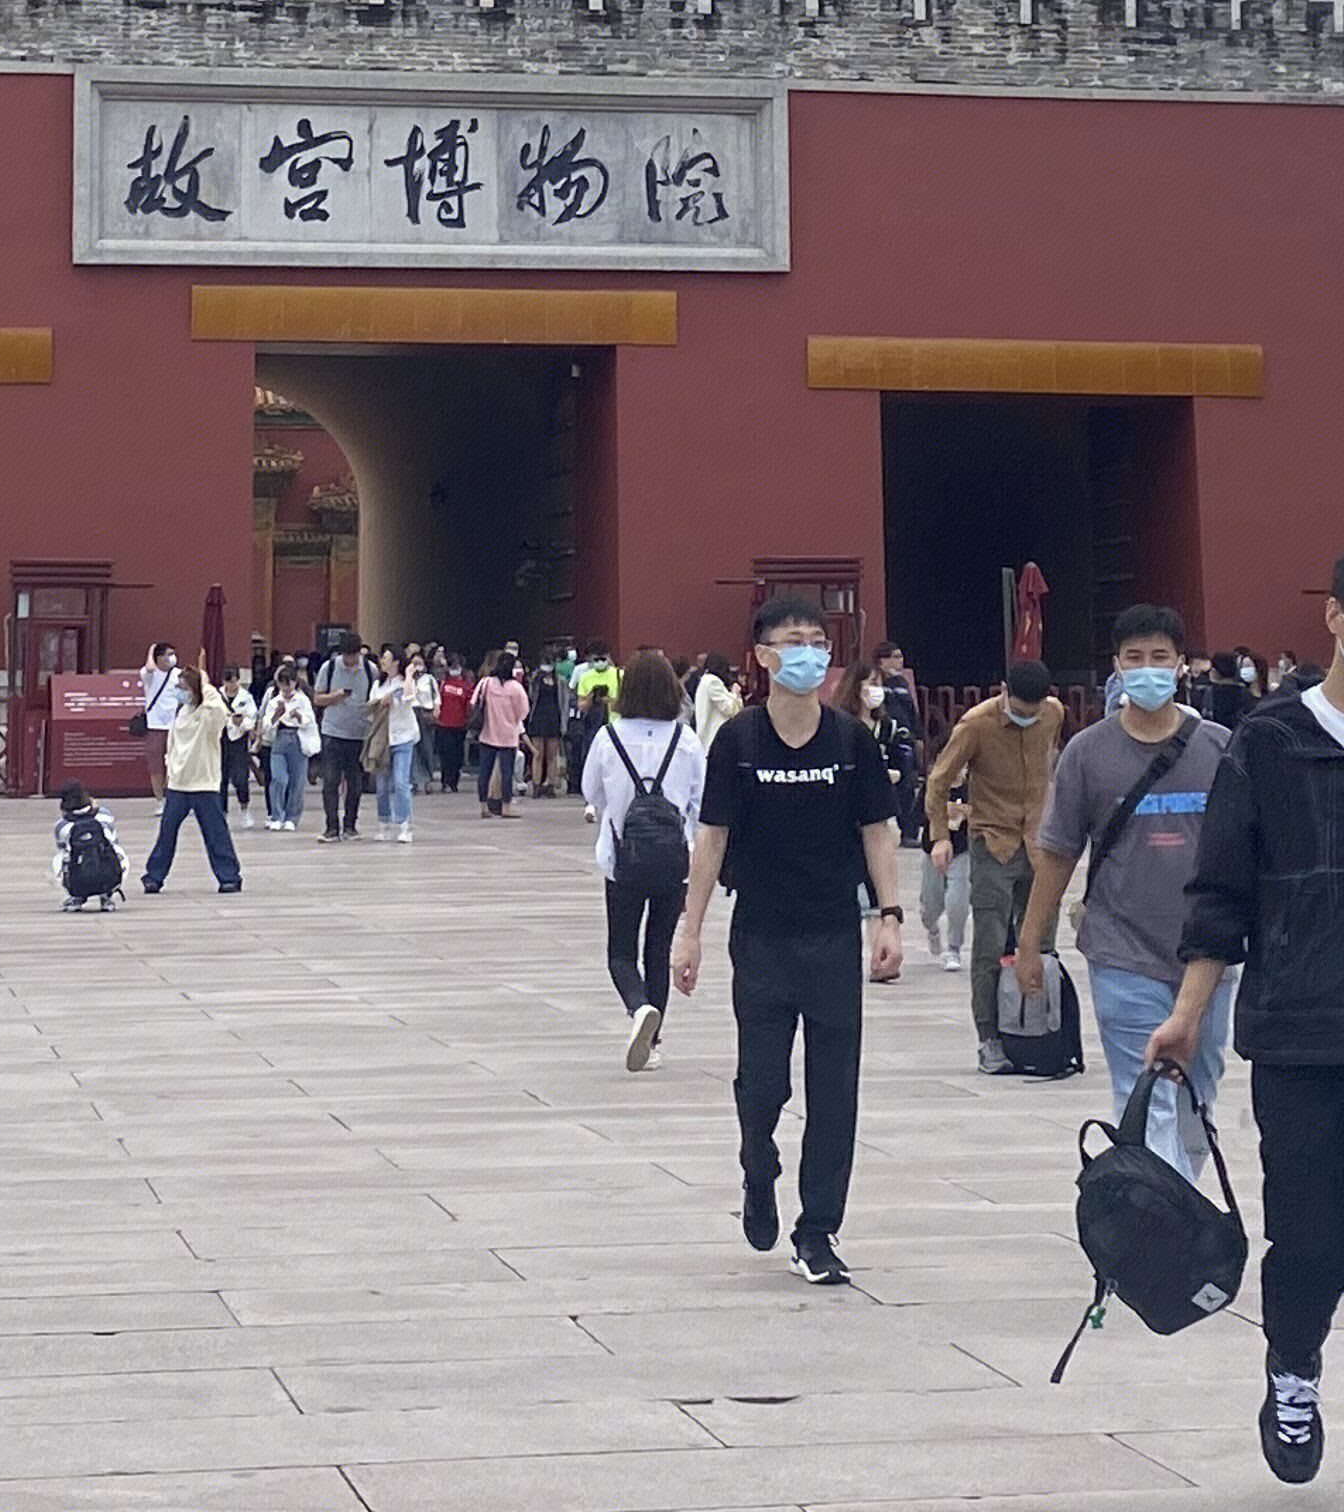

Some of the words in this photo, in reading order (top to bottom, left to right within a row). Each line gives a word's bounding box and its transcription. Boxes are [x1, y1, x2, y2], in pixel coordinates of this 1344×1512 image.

[123, 114, 731, 228] 故宫博物院
